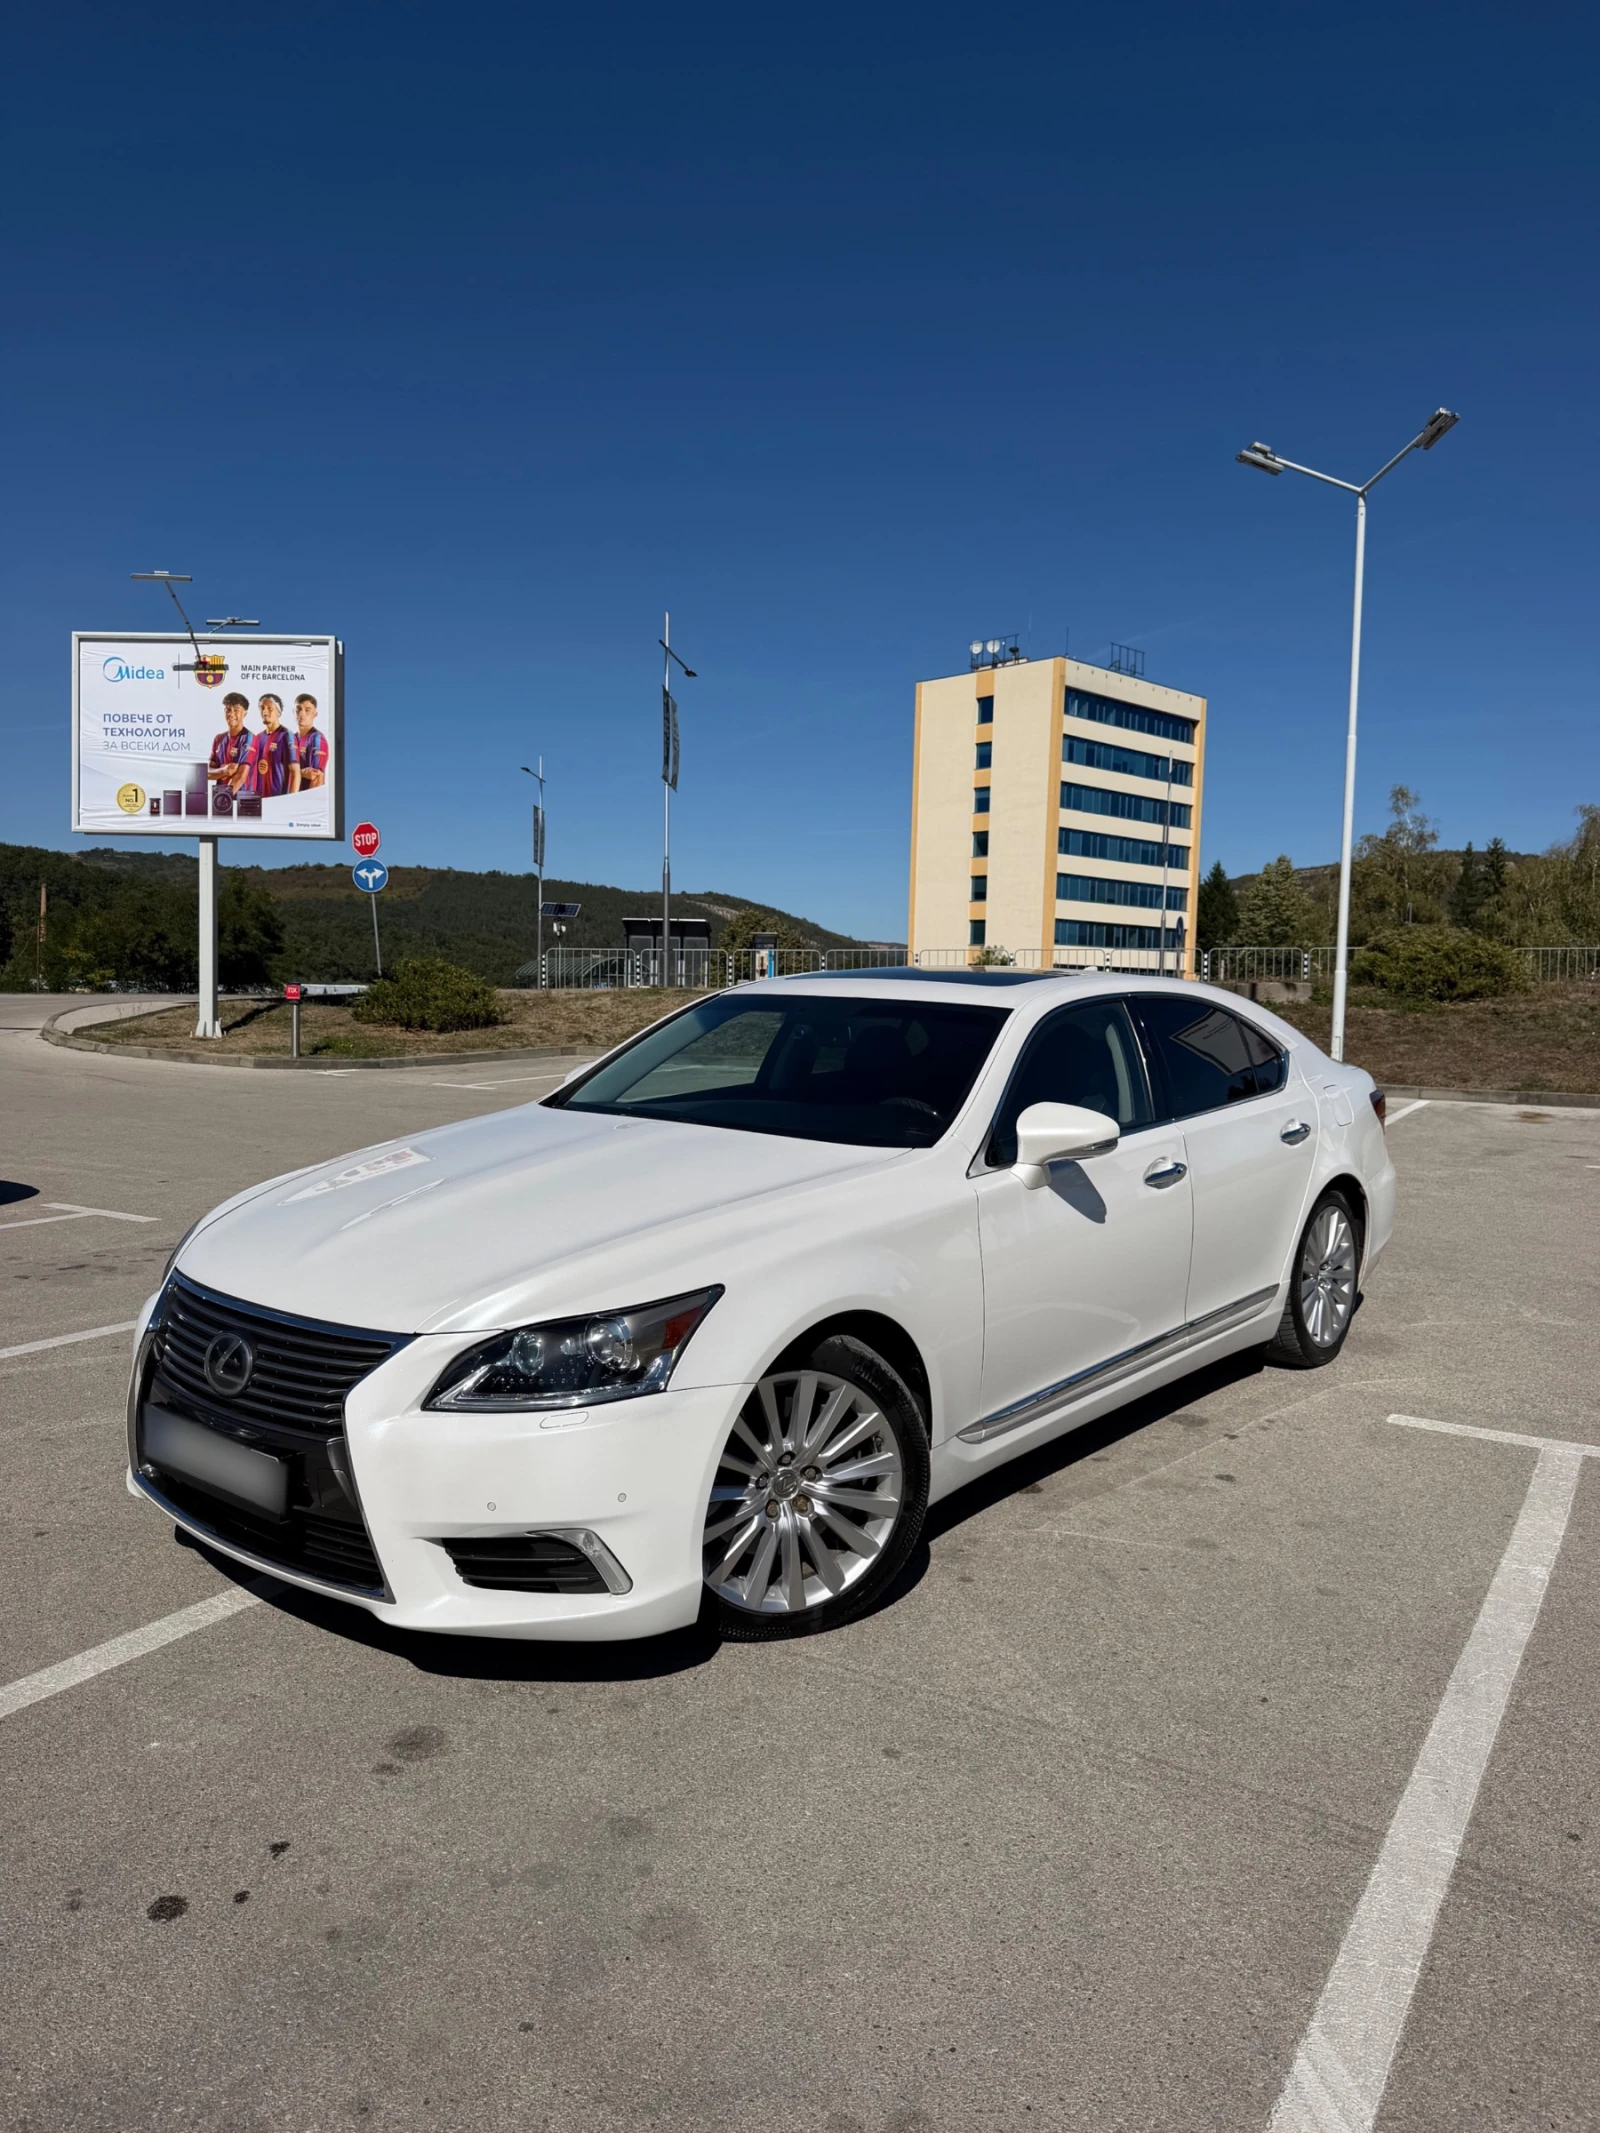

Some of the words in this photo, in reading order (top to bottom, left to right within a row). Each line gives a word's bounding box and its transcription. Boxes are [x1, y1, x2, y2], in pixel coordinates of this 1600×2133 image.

[106, 660, 164, 681] Midea
[240, 664, 261, 672] MAIN
[262, 664, 296, 673] PARTNER
[262, 673, 306, 681] BARCELONA
[103, 713, 153, 724] ПОВЕЧЕ
[156, 714, 173, 724] ОТ
[103, 727, 186, 738] ТЕХНОЛОГИЯ
[103, 741, 118, 751] ЗА
[121, 741, 159, 751] ВСЕКИ
[163, 742, 191, 752] ДОМ
[354, 832, 377, 847] STOP
